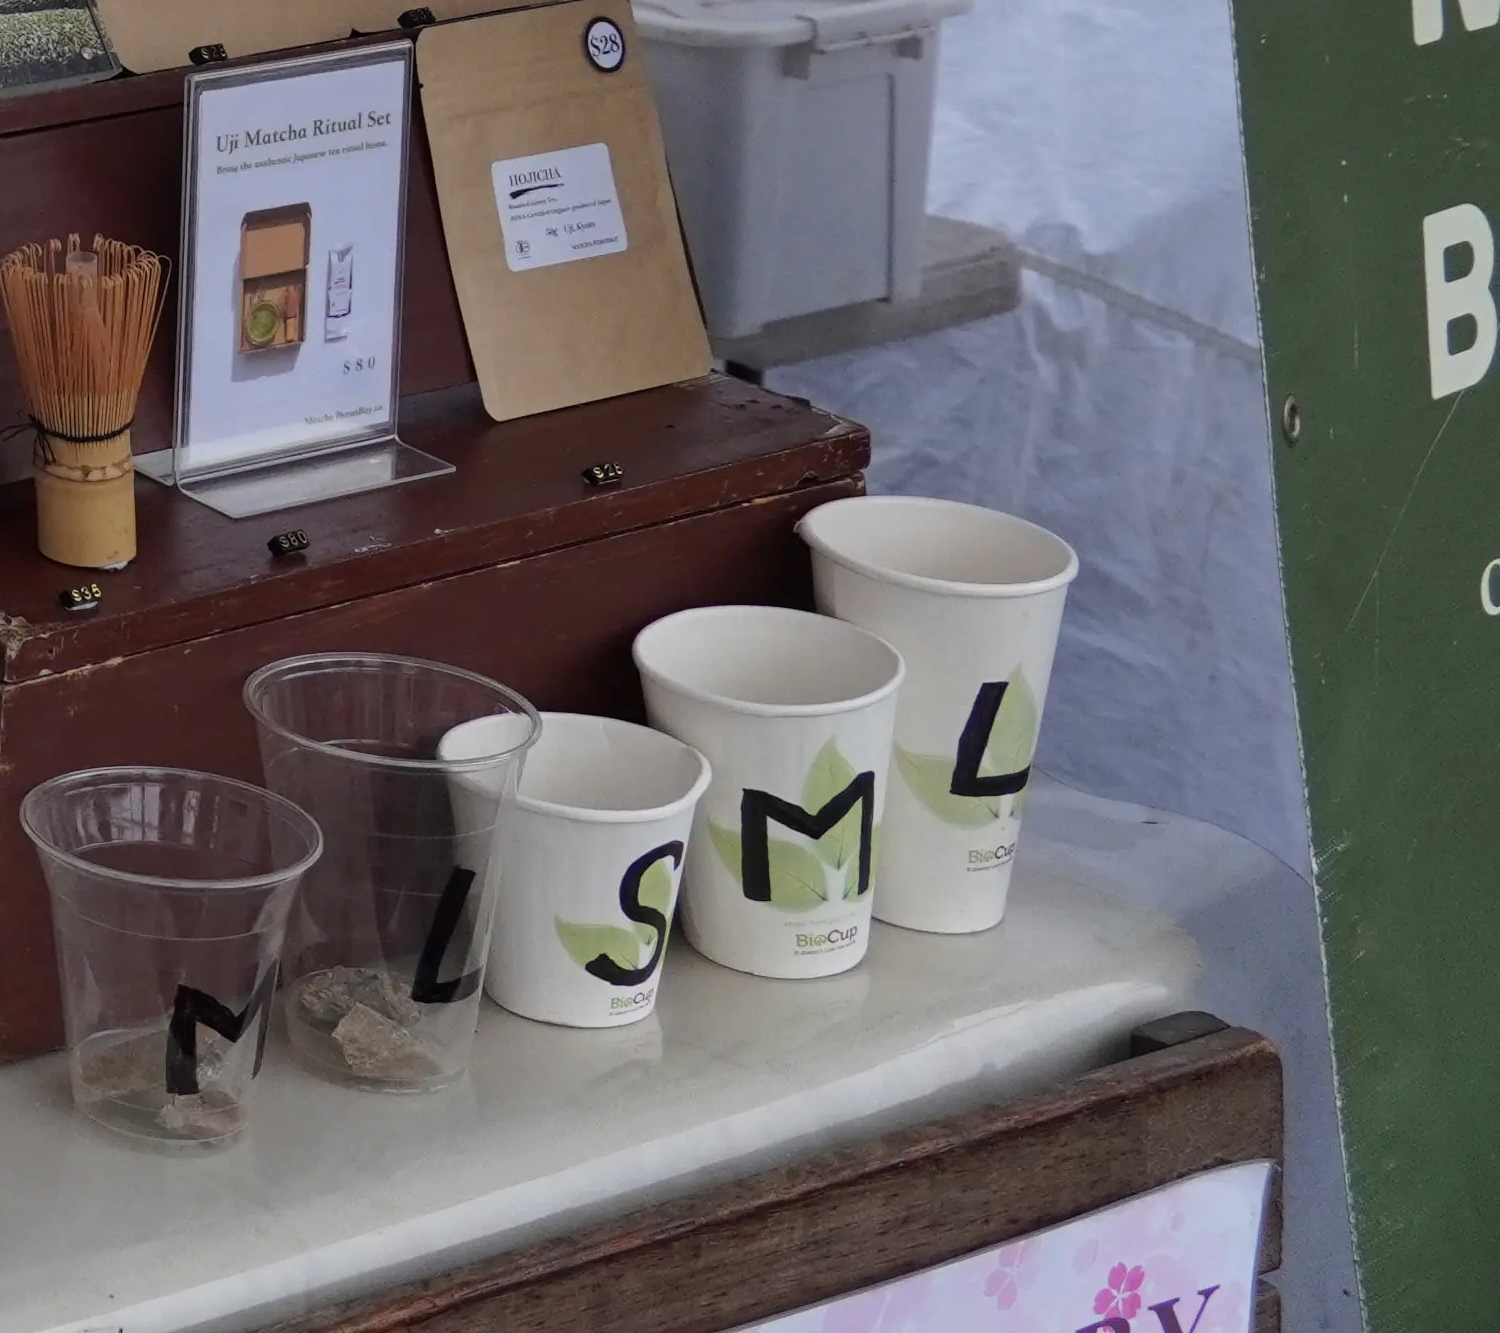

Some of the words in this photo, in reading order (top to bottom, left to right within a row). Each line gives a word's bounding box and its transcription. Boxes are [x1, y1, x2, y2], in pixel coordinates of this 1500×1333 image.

[589, 33, 621, 58] $28
[216, 133, 239, 156] Uji
[244, 123, 307, 149] Matcha
[312, 112, 363, 137] Ritual
[367, 110, 392, 129] Set
[508, 167, 562, 188] HOJICHA
[71, 583, 102, 602] $35
[948, 680, 1032, 798] L
[741, 771, 877, 902] M
[412, 867, 482, 1004] L
[585, 839, 684, 986] S
[795, 925, 858, 947] BioCup
